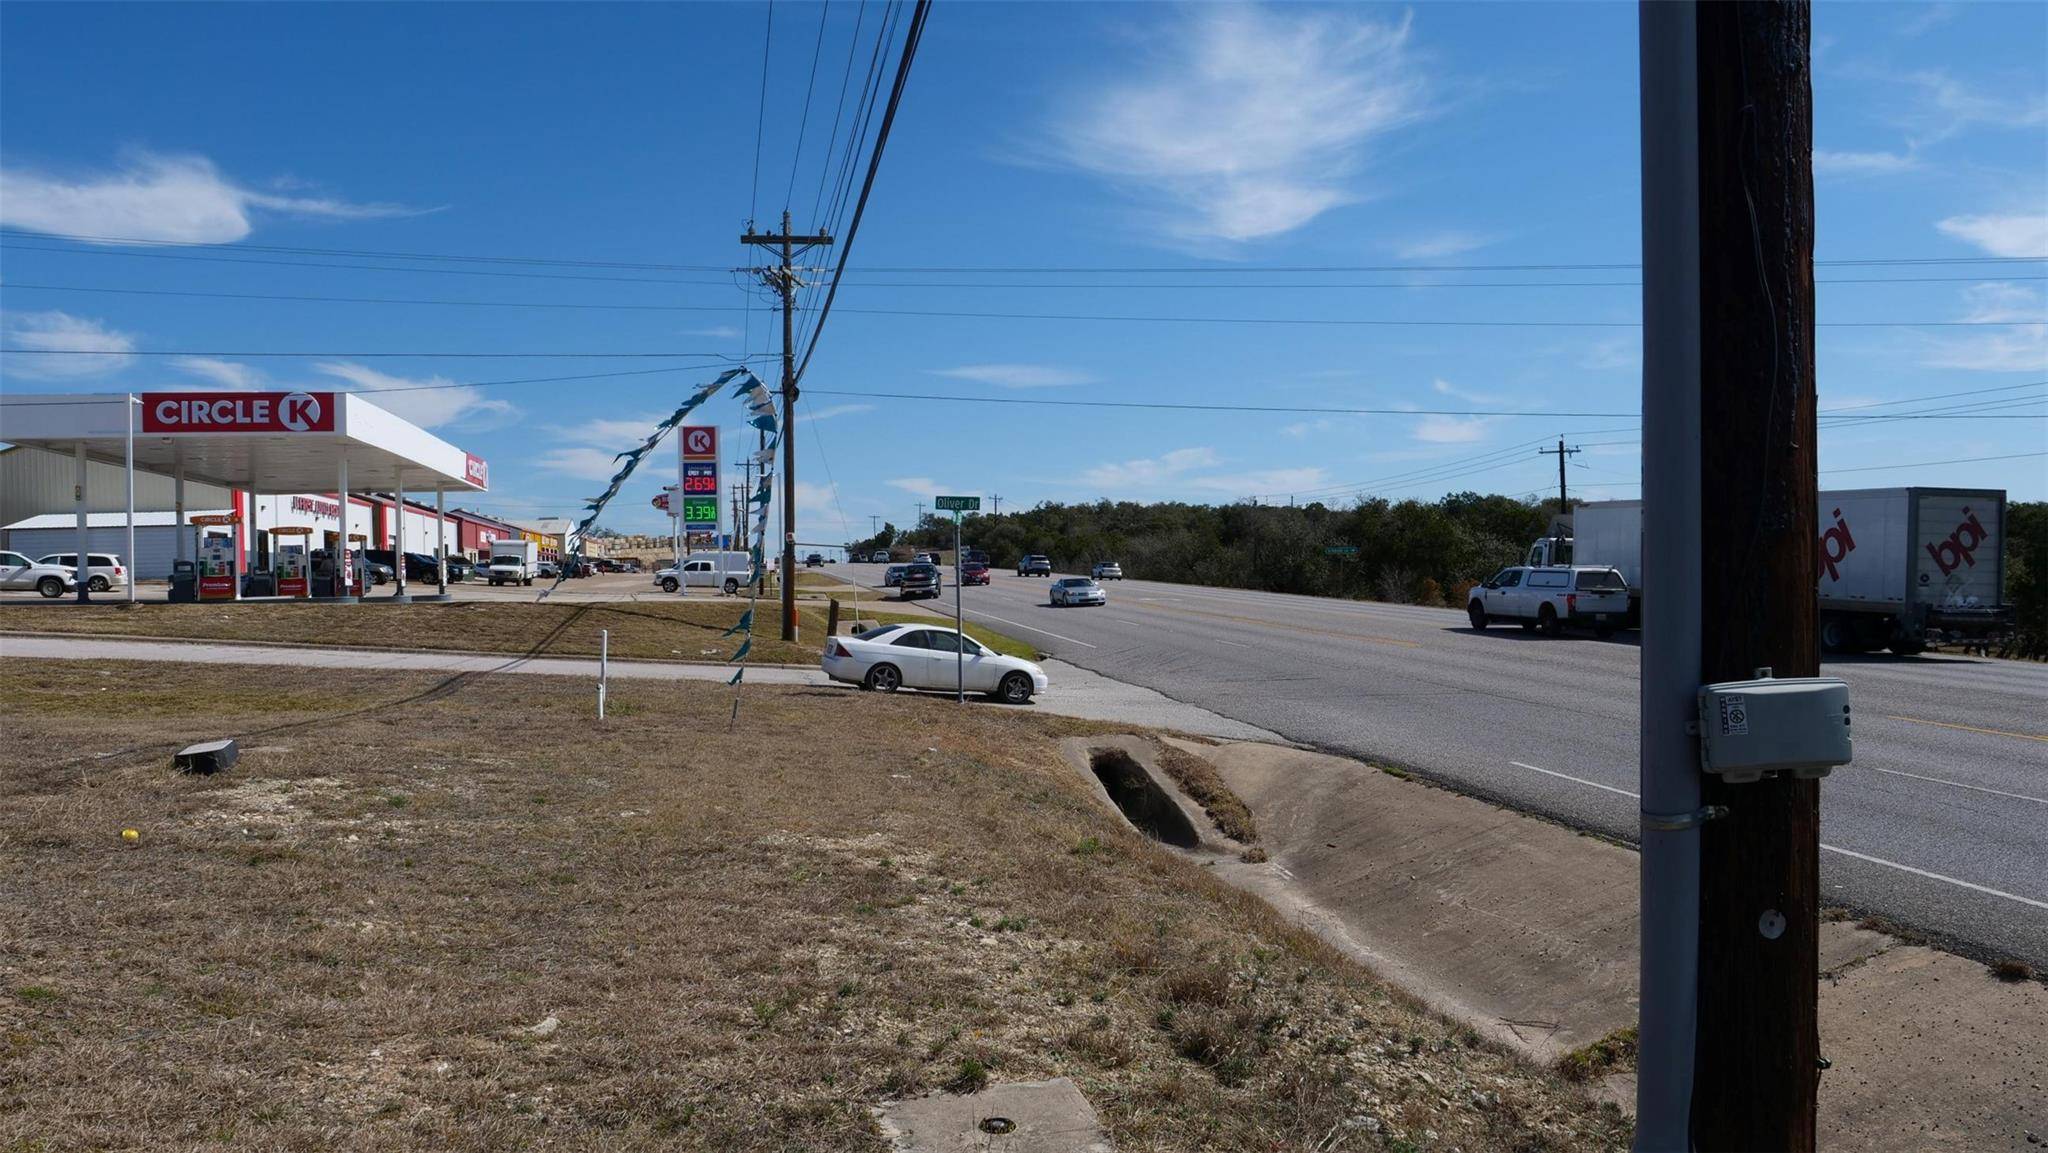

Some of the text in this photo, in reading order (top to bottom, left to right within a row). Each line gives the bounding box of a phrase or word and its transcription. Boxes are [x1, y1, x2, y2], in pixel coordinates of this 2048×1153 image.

[156, 398, 319, 431] CIRCLE K
[693, 433, 710, 451] K
[938, 498, 979, 509] Oliver Dr
[1819, 508, 1856, 582] pi
[1926, 506, 1988, 577] bpi
